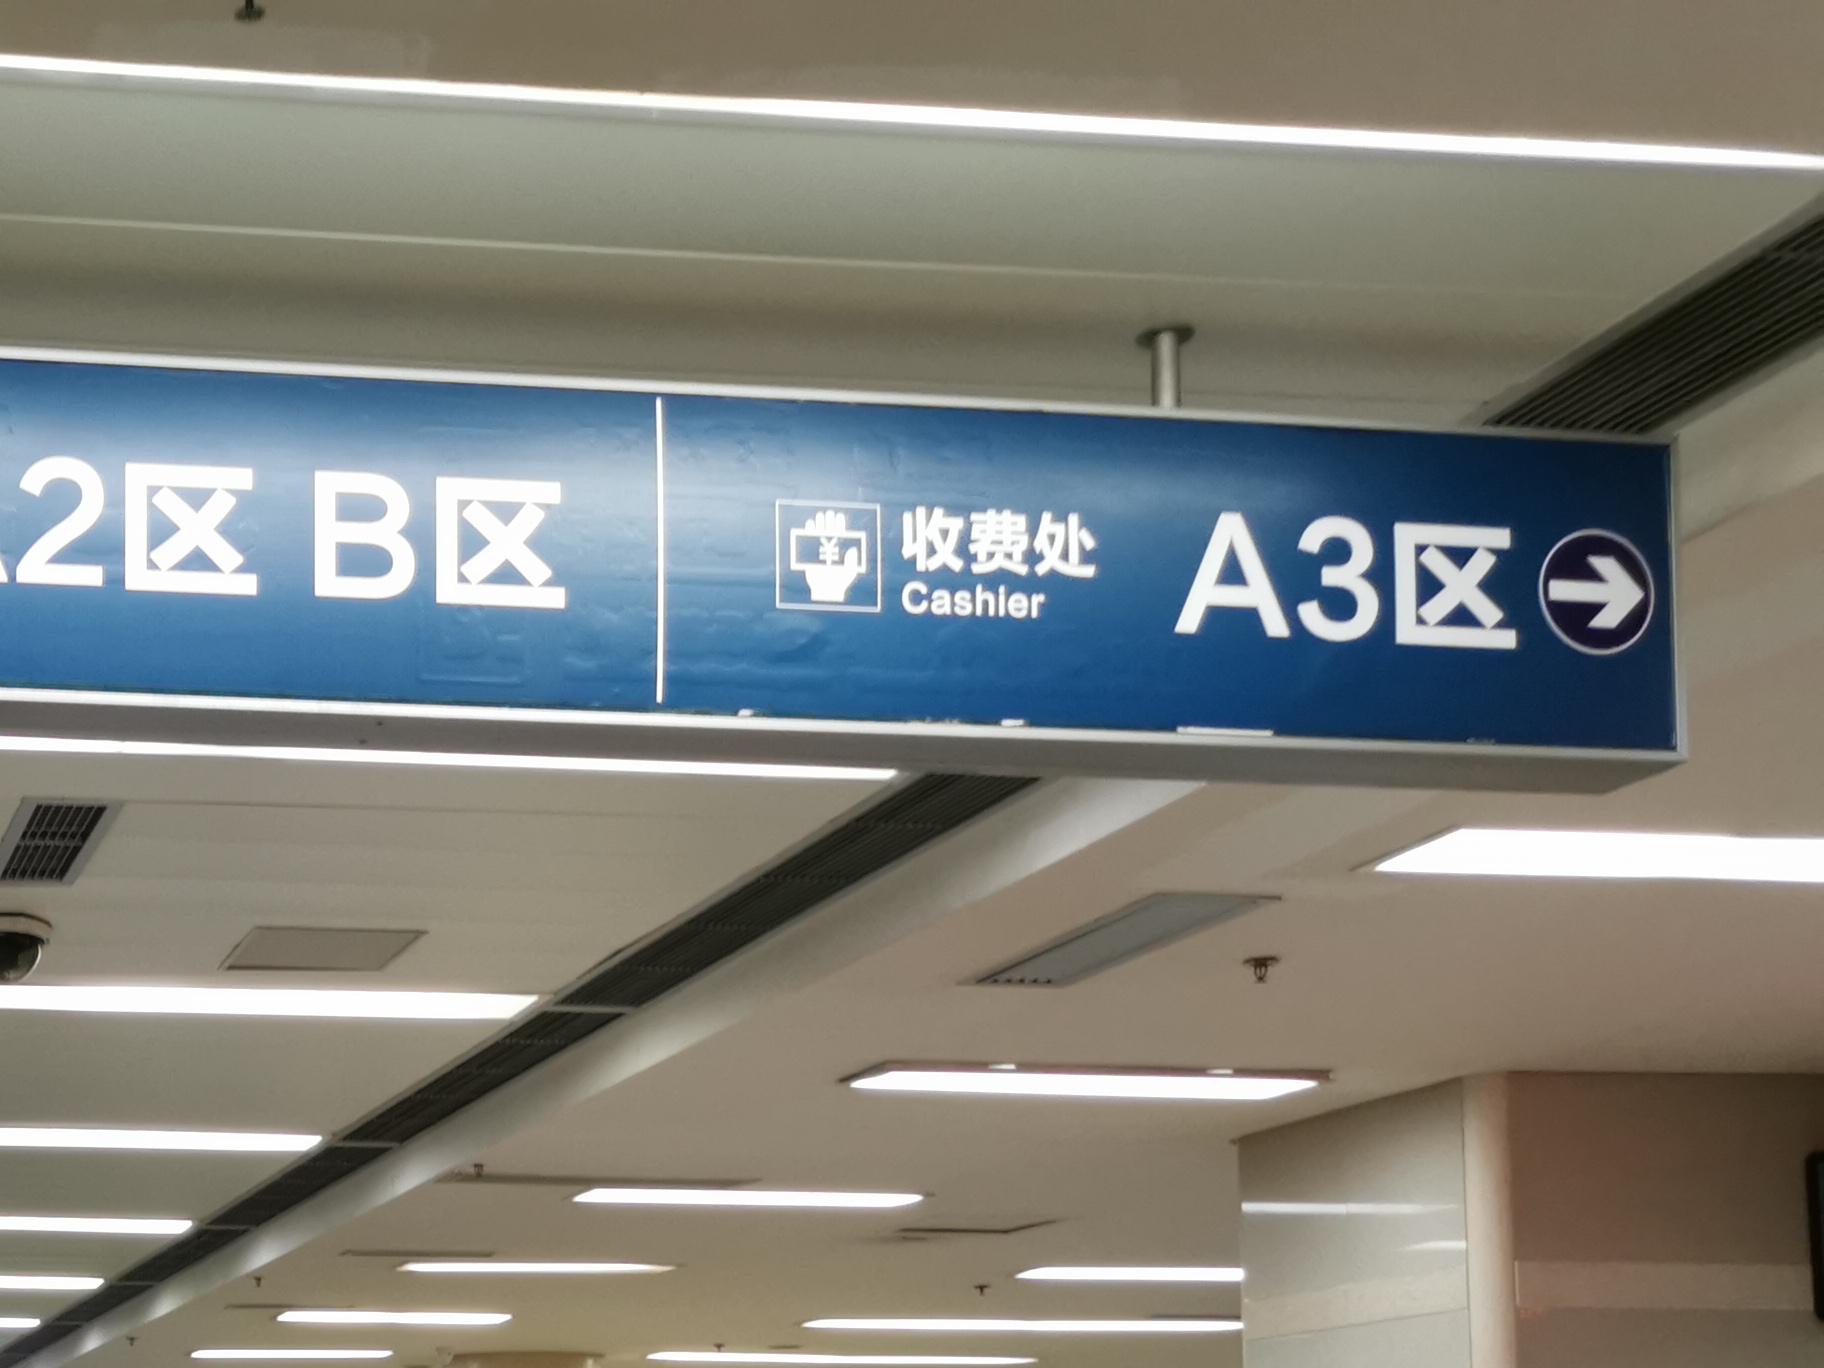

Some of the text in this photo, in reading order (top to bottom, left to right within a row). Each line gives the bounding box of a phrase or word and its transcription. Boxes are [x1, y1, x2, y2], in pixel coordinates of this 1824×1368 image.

[313, 470, 566, 608] B区
[901, 505, 1096, 579] 收费处
[1174, 511, 1517, 648] A3区
[901, 581, 1046, 619] Cashier
